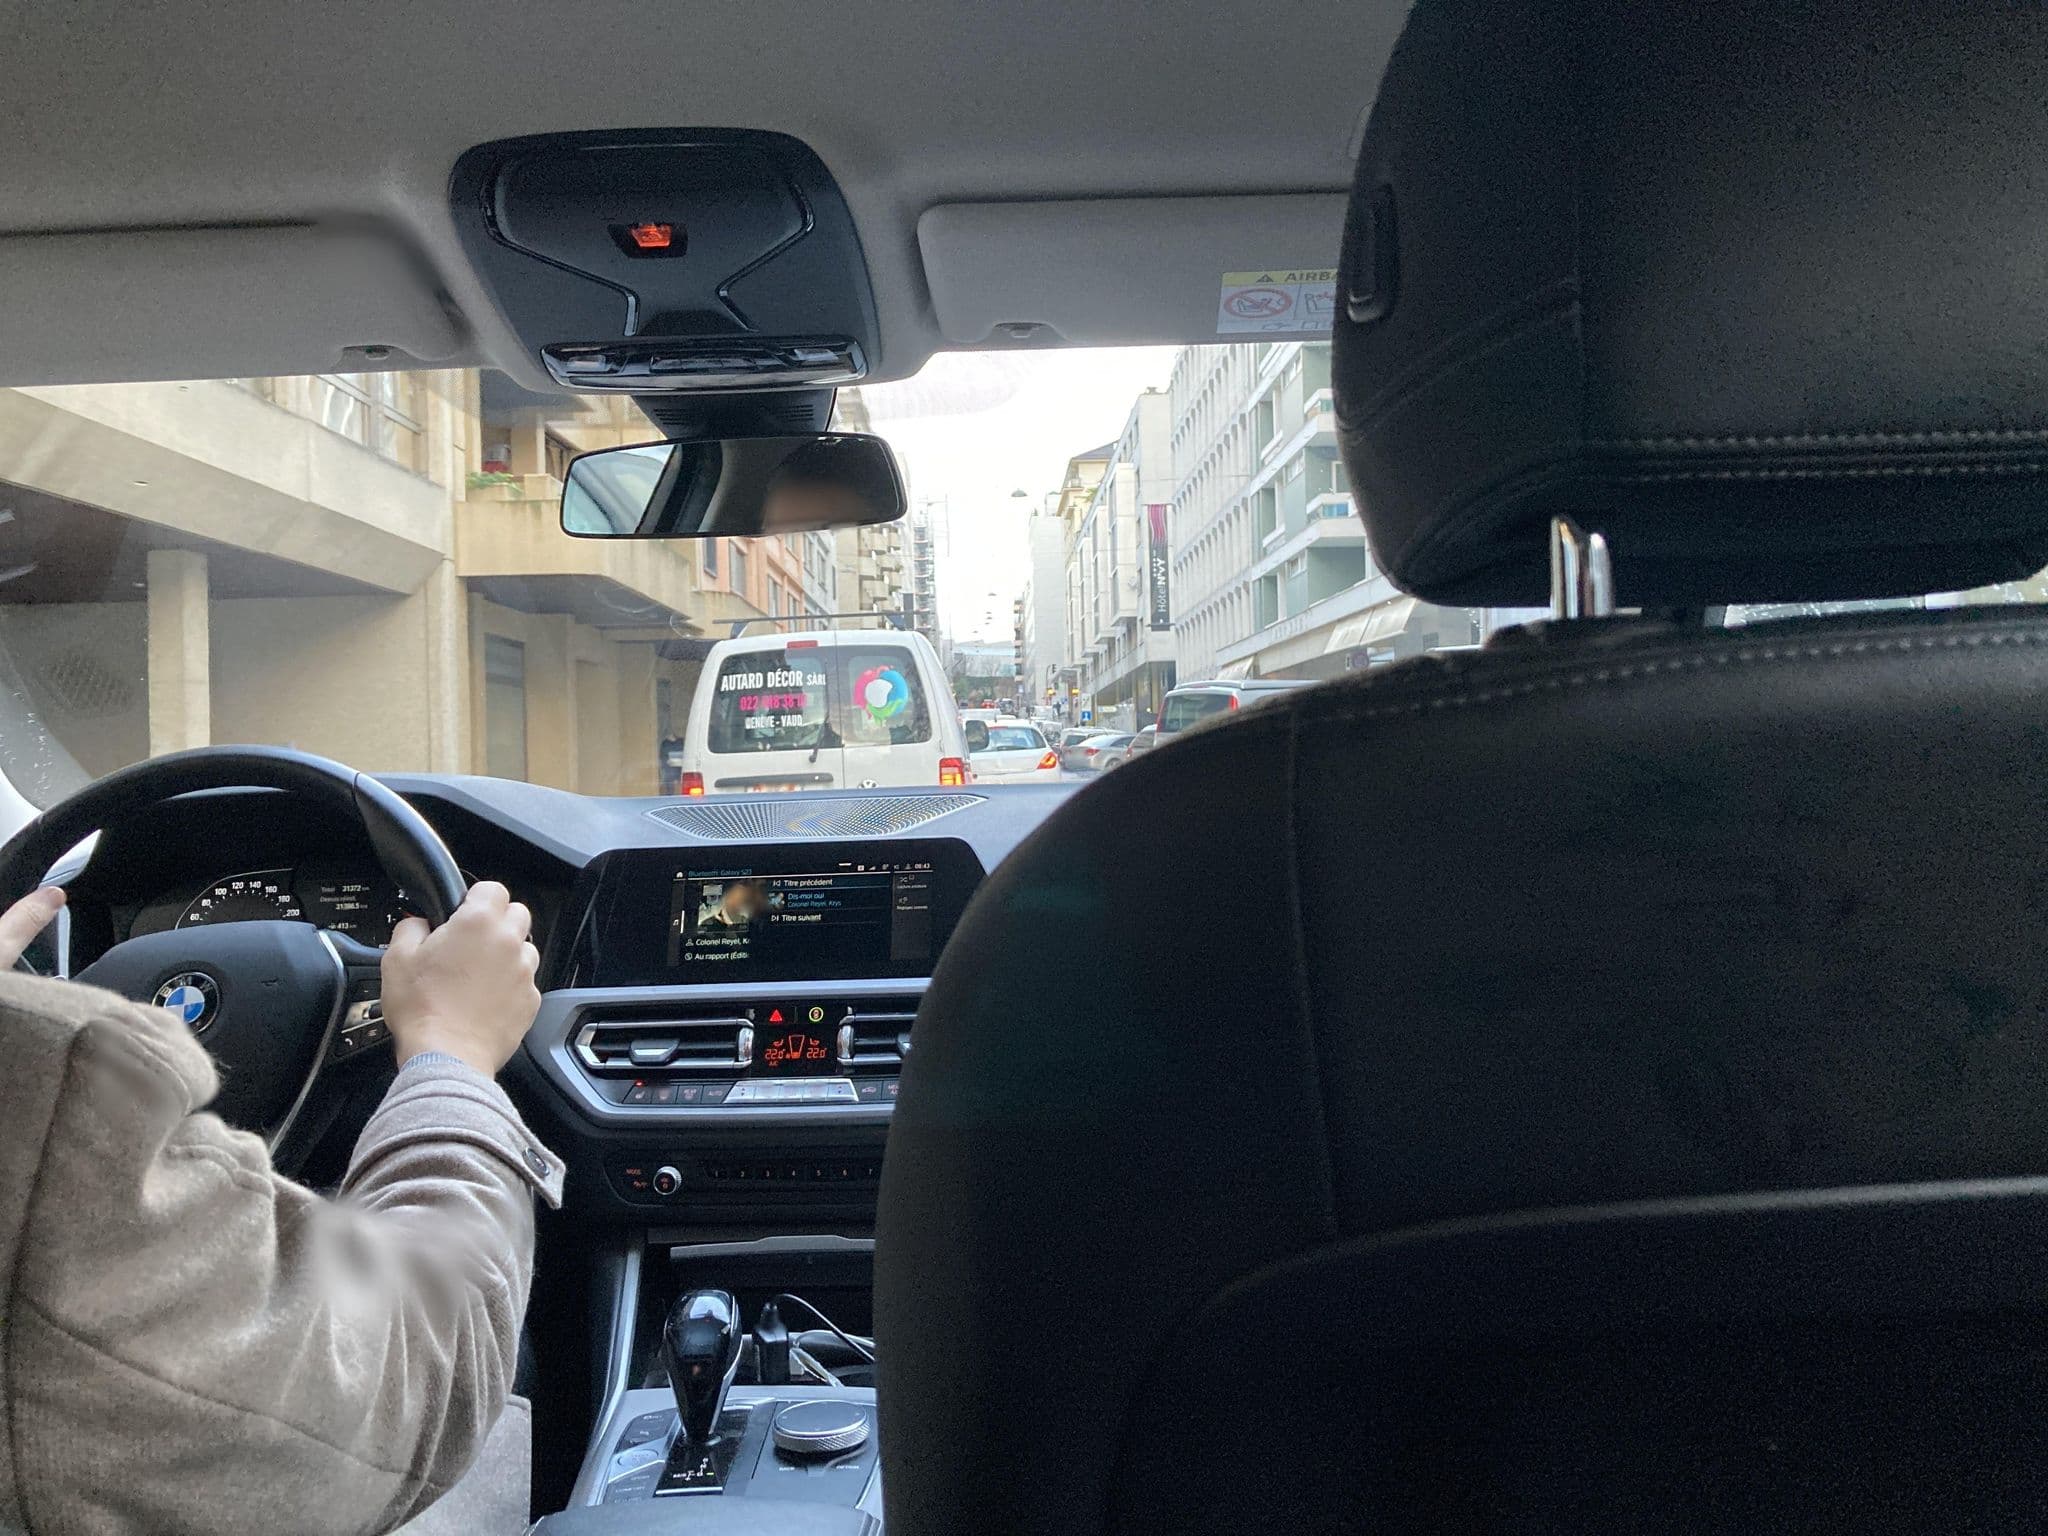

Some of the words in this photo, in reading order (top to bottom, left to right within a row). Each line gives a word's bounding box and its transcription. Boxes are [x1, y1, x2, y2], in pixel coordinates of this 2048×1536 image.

[720, 672, 763, 692] AUTARD
[767, 668, 803, 688] DÉCOR
[739, 695, 759, 711] 022
[780, 714, 803, 728] VAUD
[231, 881, 244, 889] 120
[784, 879, 798, 887] Titre
[214, 887, 227, 895] 100
[265, 885, 277, 893] 160
[202, 899, 211, 907] 80
[190, 913, 200, 921] 60
[386, 914, 392, 923] 1
[695, 938, 720, 946] Colonel
[705, 952, 729, 961] rapport
